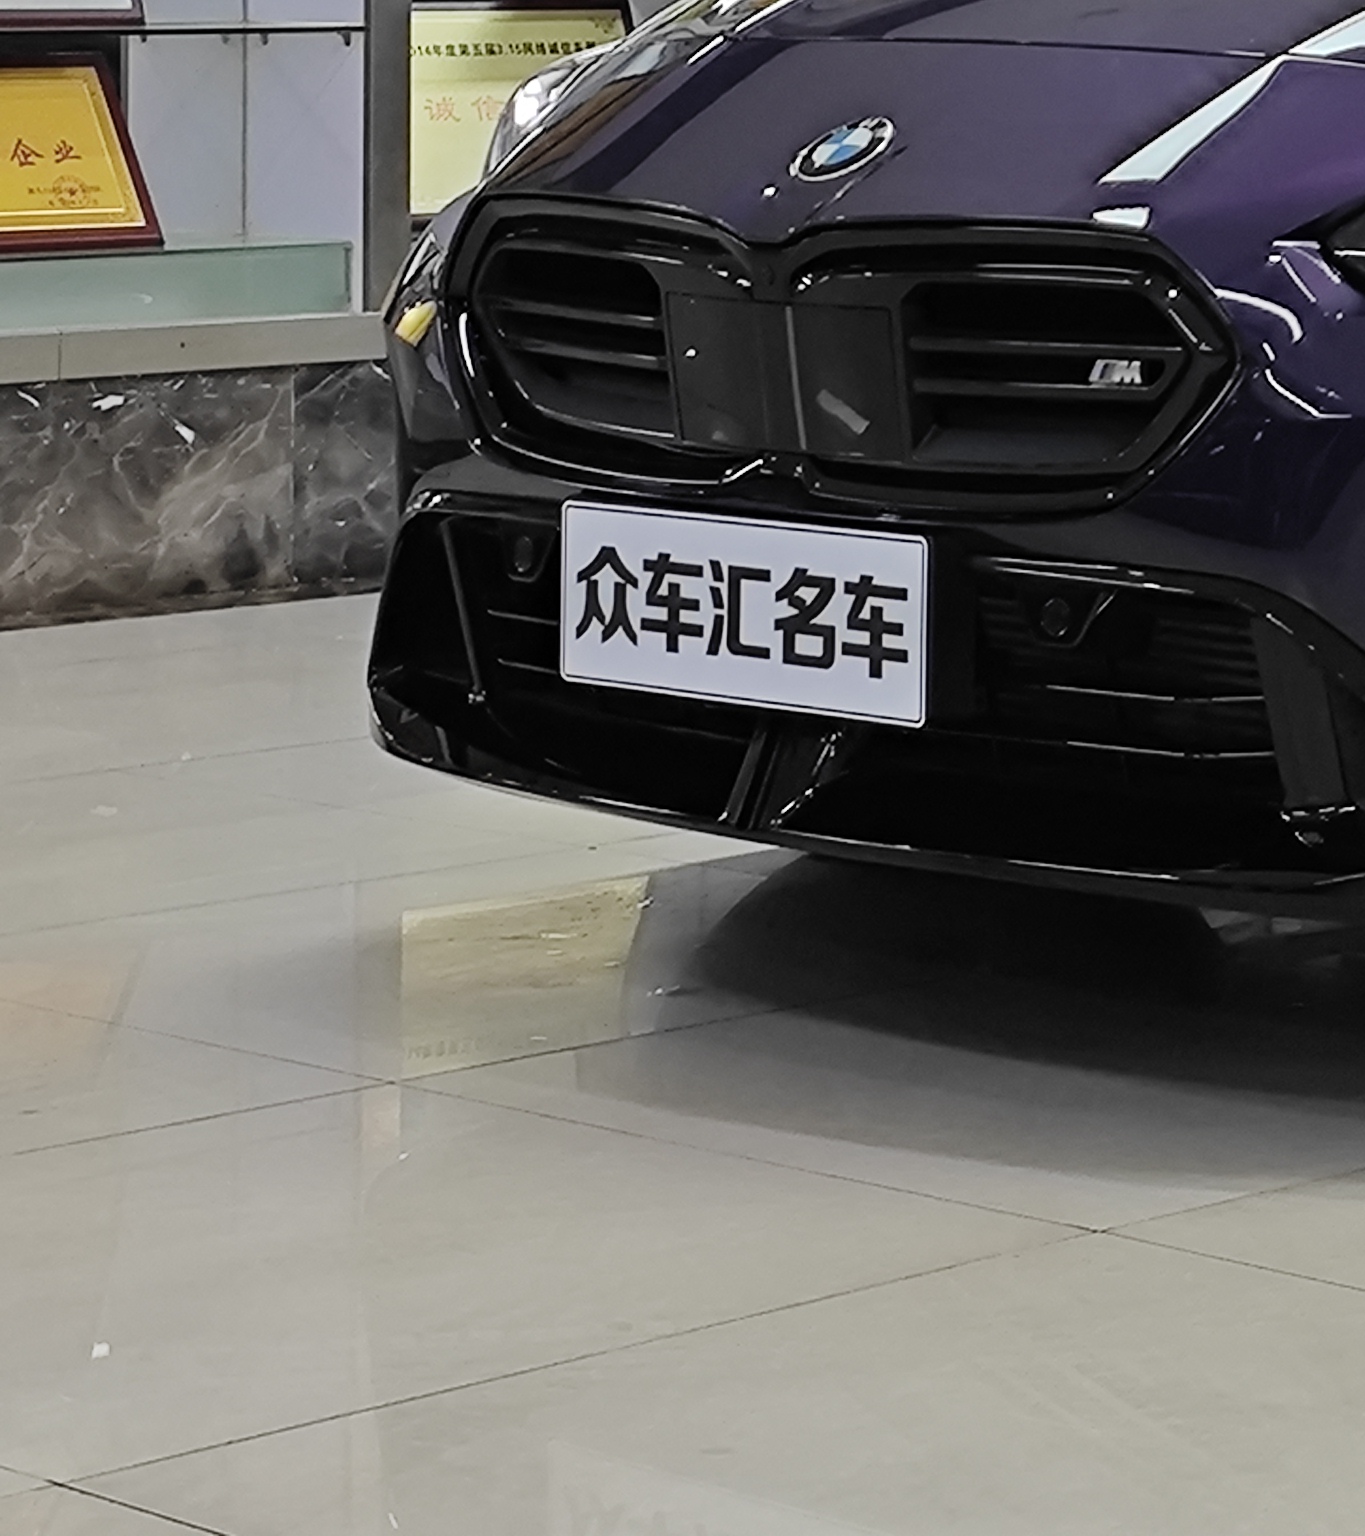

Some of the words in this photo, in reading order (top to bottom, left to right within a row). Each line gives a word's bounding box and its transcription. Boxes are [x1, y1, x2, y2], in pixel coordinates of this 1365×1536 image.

[10, 137, 82, 167] 企业
[575, 545, 909, 680] 众车汇名车
